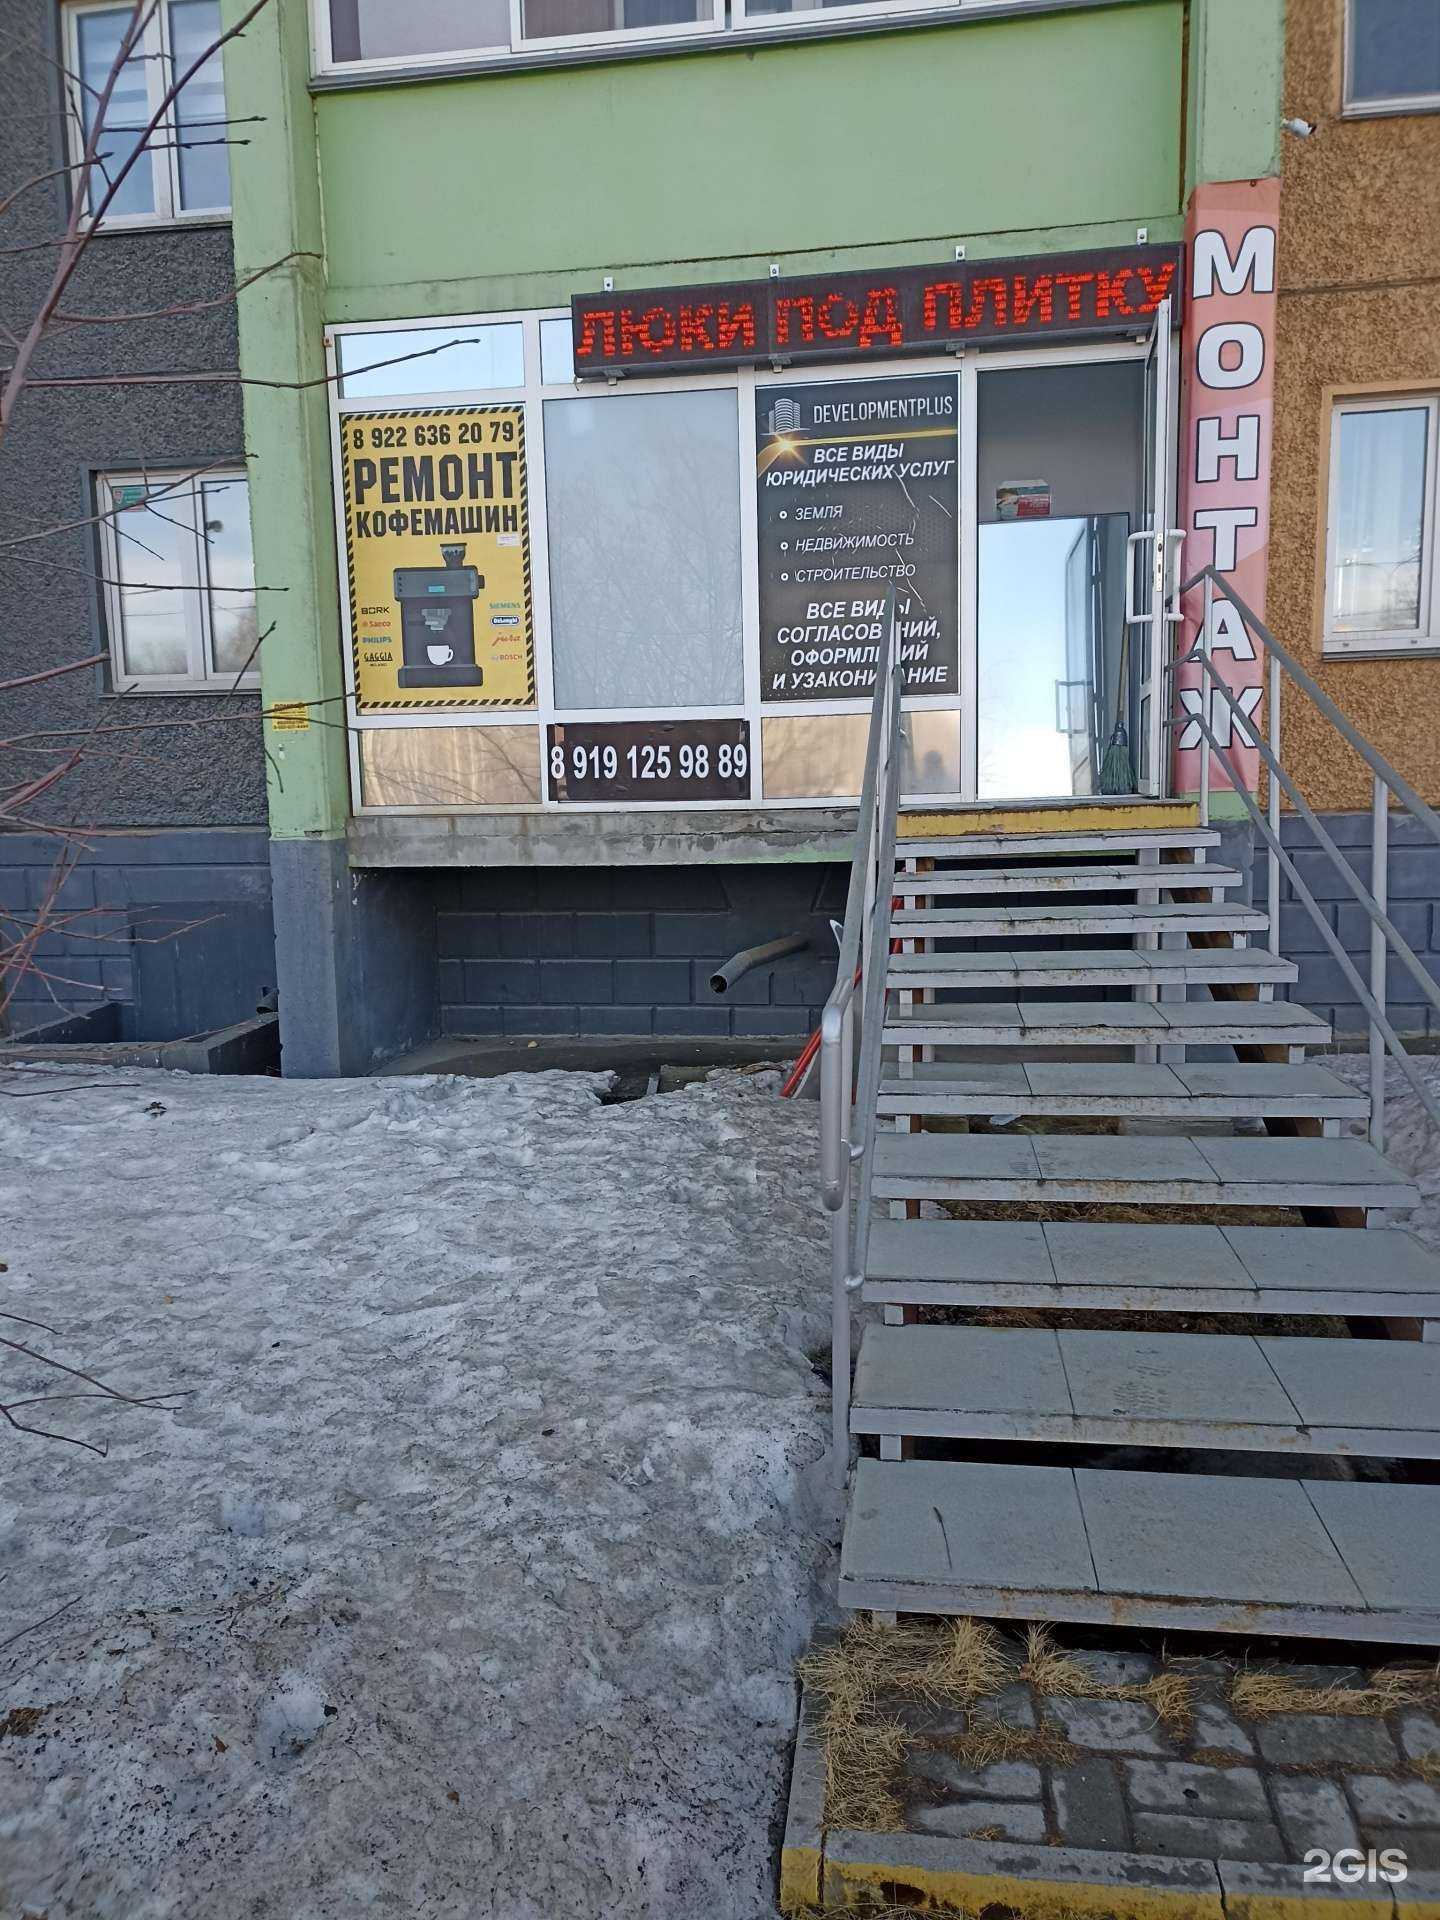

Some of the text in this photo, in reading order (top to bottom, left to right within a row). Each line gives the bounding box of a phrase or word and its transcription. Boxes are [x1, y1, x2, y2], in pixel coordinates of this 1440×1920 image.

[576, 262, 1176, 357] ЛЮКИ ПОД ПЛИТКУ
[813, 396, 953, 425] DEVELOPMENTPLUS
[353, 421, 514, 450] 8 922 636 20 79
[814, 443, 904, 464] ВСЕ ВИДЫ
[353, 451, 518, 505] РЕМОНТ
[765, 460, 955, 488] ЮРИДИЧЕСКИХ УСЛУГ
[1178, 224, 1276, 750] МОНТАЖ
[356, 504, 518, 538] КОФЕМАШИН
[795, 505, 843, 521] ЗЕМЛЯ
[795, 533, 915, 554] НЕДВИЖИМОСТЬ
[796, 564, 916, 583] СТРОИТЕЛЬСТВО
[361, 606, 390, 615] BORK
[806, 600, 846, 619] ВСЕ
[362, 636, 392, 644] PHILIPS
[777, 616, 941, 644] СОГЛАСОВНИЙ,
[364, 651, 393, 662] GAGGIA
[790, 640, 929, 667] ОФОРМЛИЙ
[772, 674, 787, 691] И
[550, 743, 748, 779] 8 919 125 98 89
